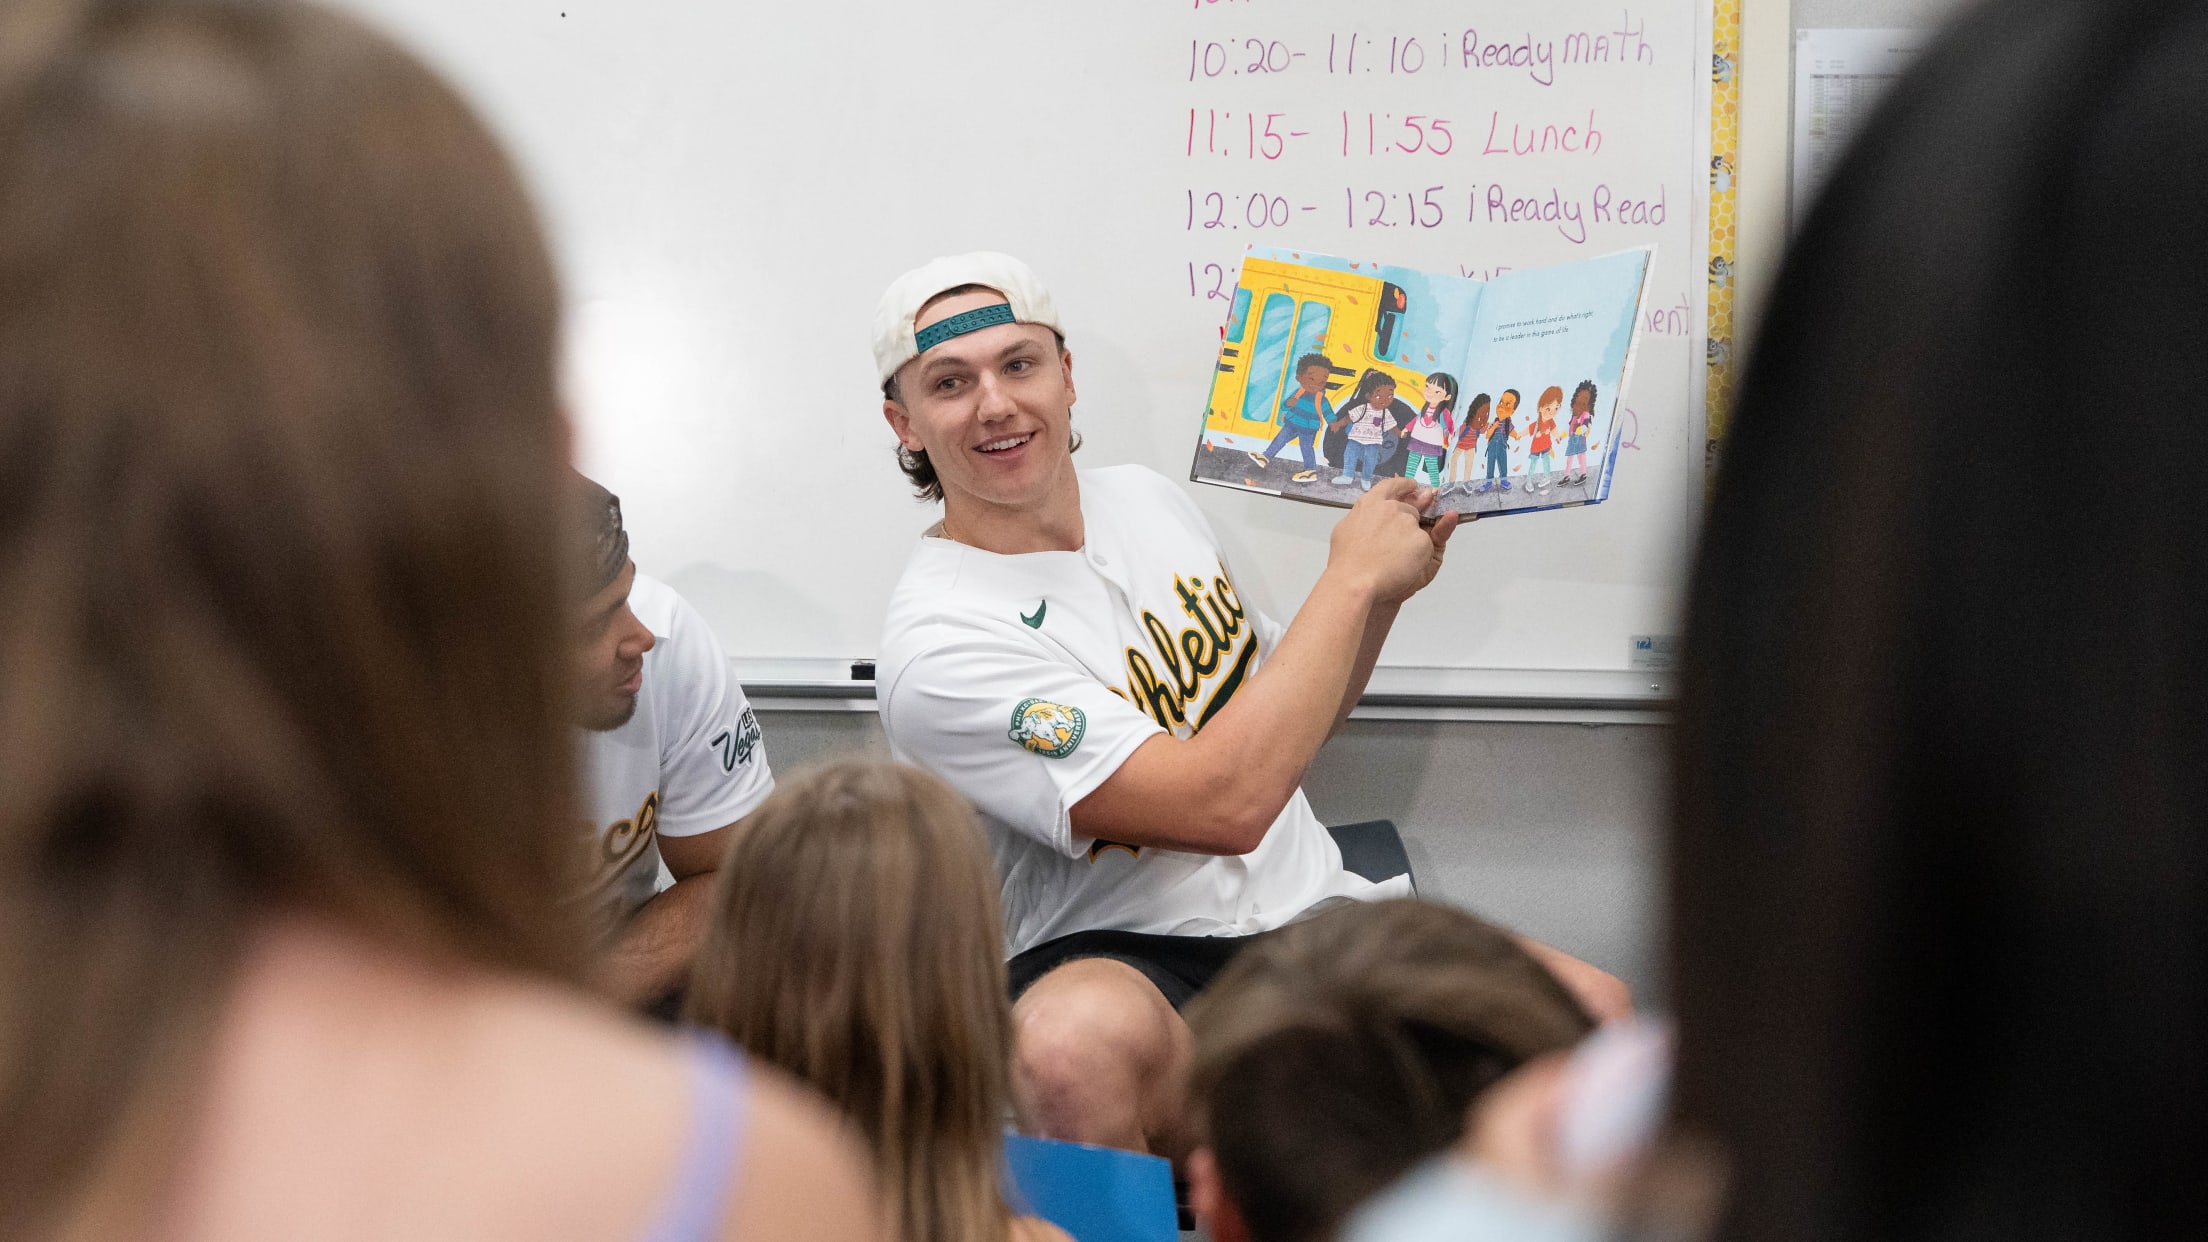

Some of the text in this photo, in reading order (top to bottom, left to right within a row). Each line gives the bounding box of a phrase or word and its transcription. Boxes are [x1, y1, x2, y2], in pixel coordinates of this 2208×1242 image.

[1343, 109, 1453, 157] 11:55
[1482, 108, 1603, 157] Lunch
[1346, 185, 1445, 229] 12:15
[1593, 183, 1667, 226] Read
